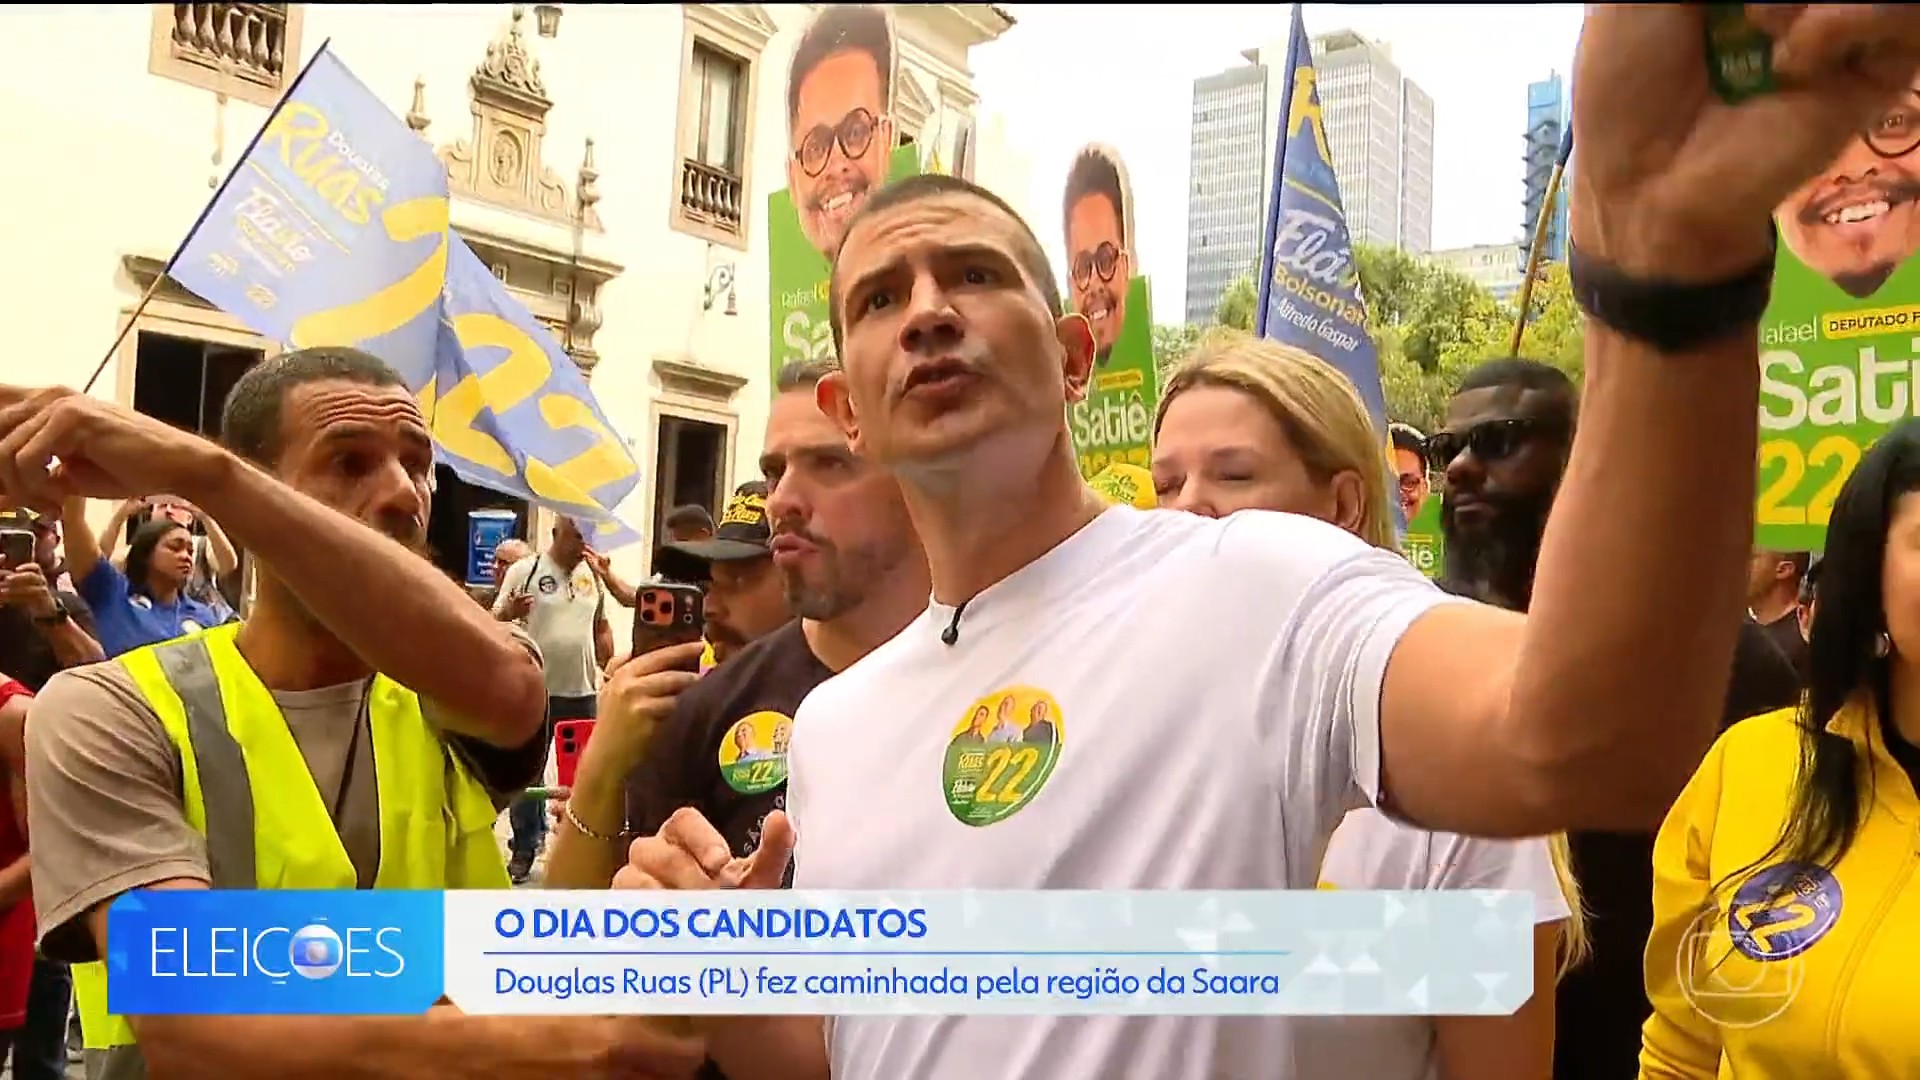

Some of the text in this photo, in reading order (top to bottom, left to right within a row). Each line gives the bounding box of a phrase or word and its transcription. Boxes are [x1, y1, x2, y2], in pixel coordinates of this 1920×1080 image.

[1274, 264, 1368, 327] Bolsona
[1829, 311, 1908, 332] DEPUTADO
[1278, 297, 1359, 352] Alfredo Gaspar
[1759, 315, 1817, 344] afael
[1073, 389, 1149, 448] Satiê
[1757, 435, 1877, 526] 22
[750, 760, 775, 785] 22
[976, 746, 1040, 803] 22
